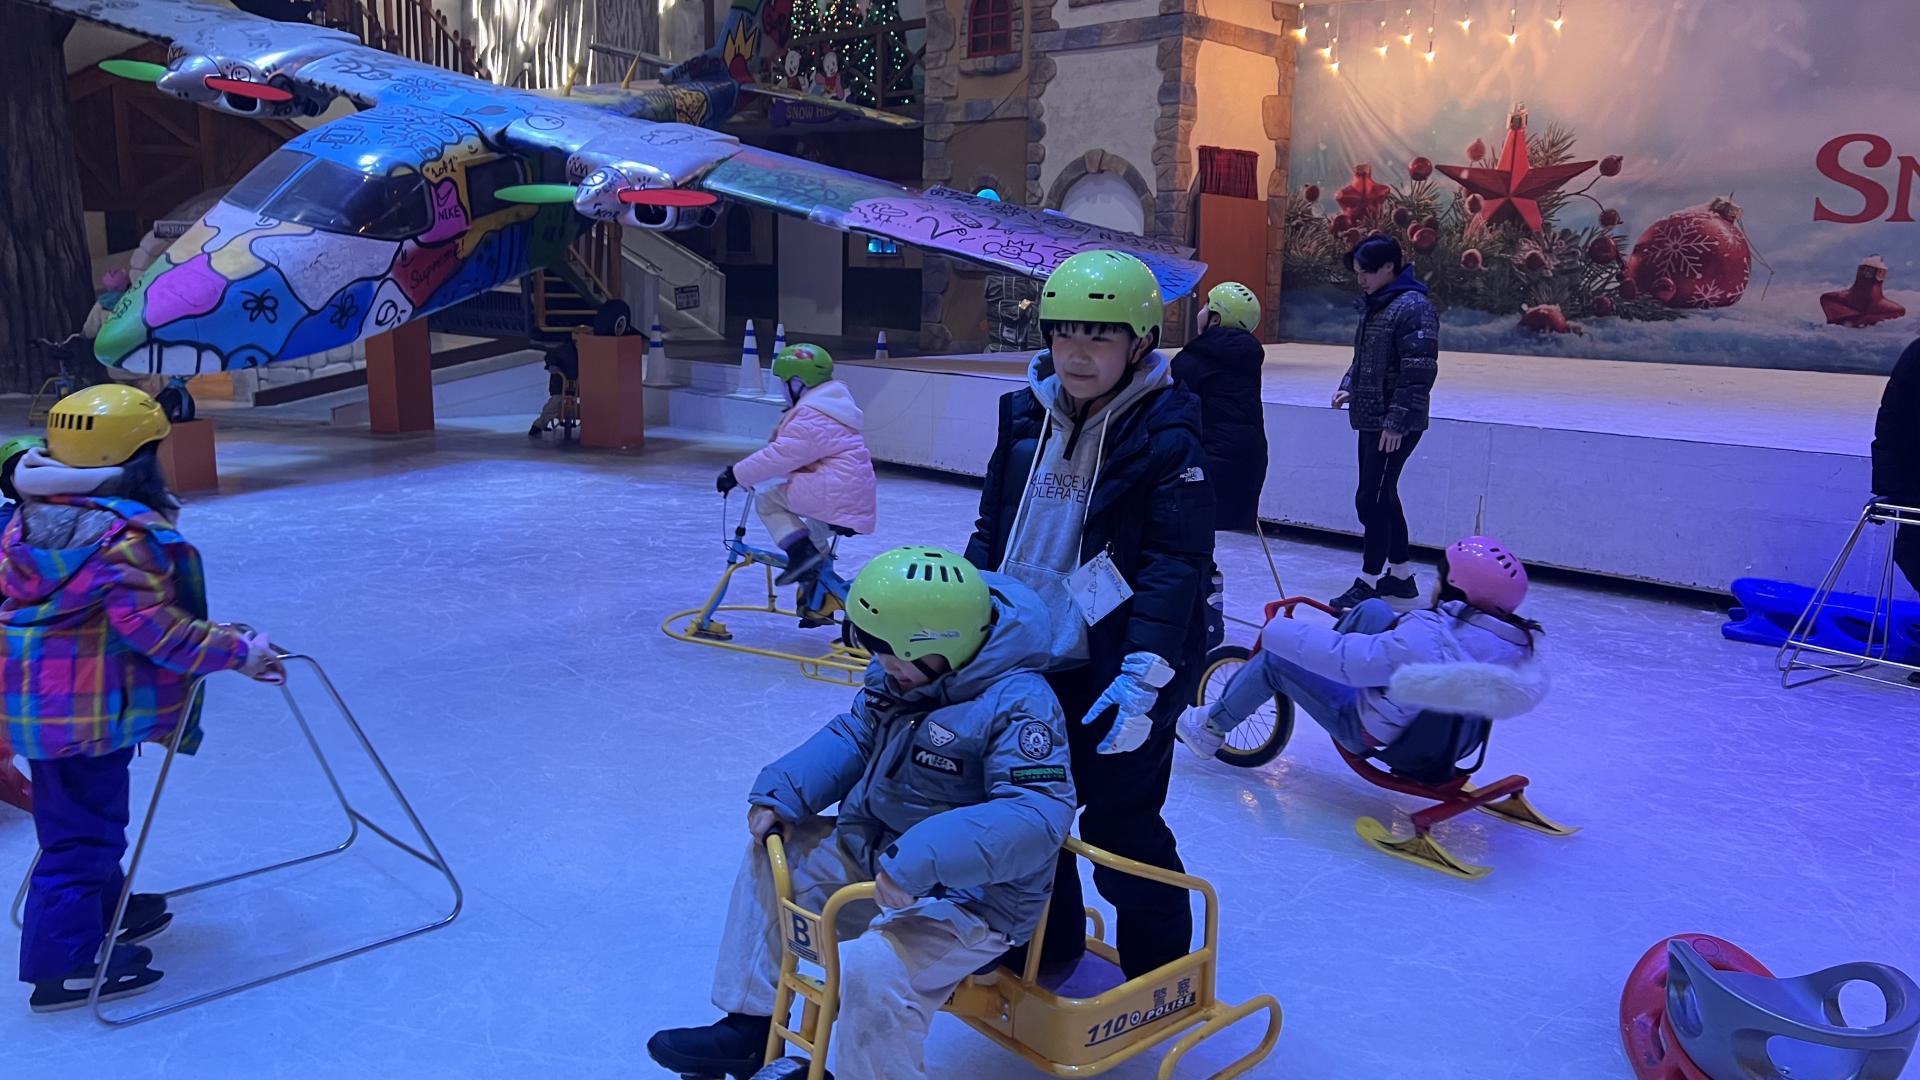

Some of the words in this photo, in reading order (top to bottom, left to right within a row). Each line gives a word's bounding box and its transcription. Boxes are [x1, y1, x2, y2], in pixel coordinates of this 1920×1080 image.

[785, 104, 814, 120] SNOW
[438, 207, 461, 221] NIKE
[792, 912, 811, 947] B
[1088, 1013, 1128, 1042] 110
[1145, 994, 1192, 1020] POLISE
